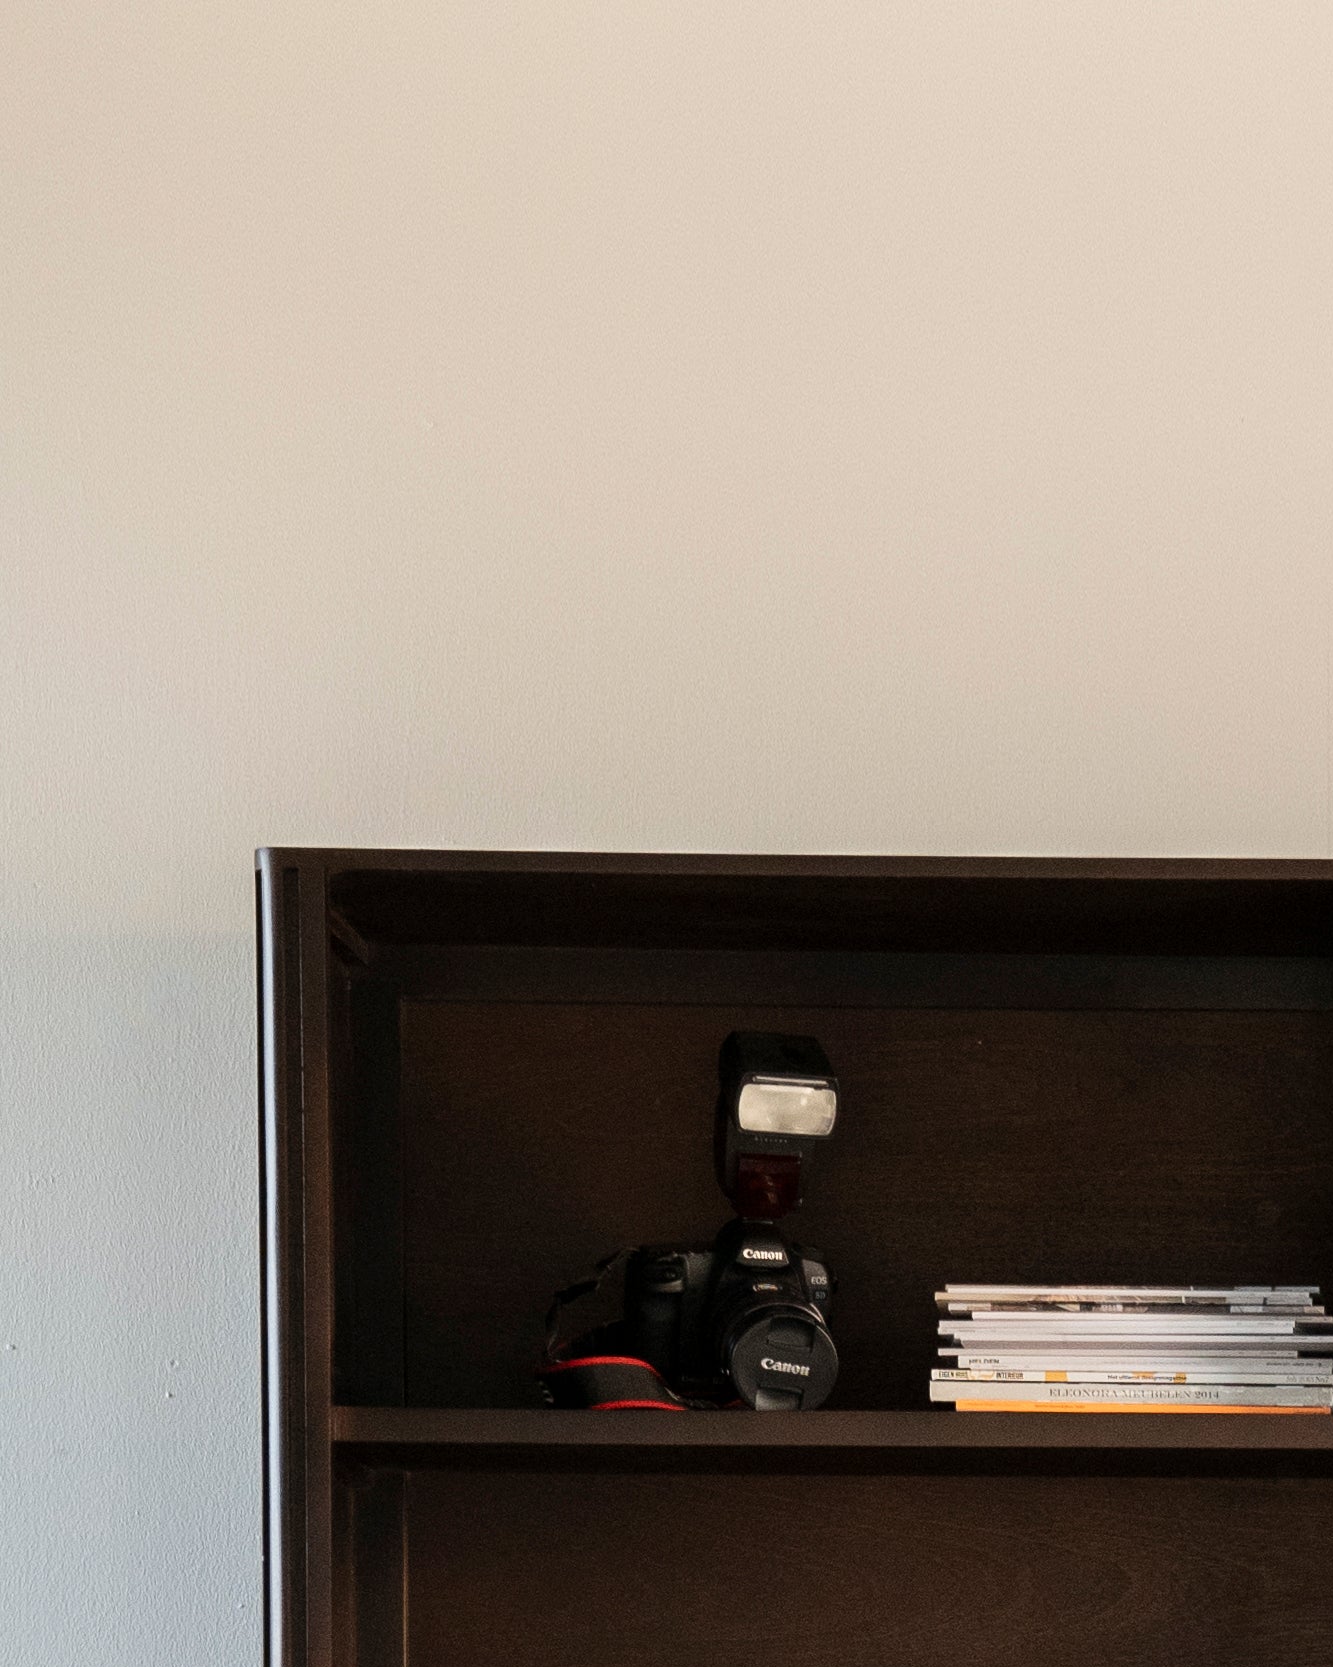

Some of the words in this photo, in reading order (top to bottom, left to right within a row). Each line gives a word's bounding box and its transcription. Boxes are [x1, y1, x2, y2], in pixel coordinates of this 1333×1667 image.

[742, 1248, 783, 1261] Canon
[811, 1276, 827, 1285] EOS
[761, 1357, 811, 1377] Canon
[1049, 1387, 1119, 1398] ELEONORA
